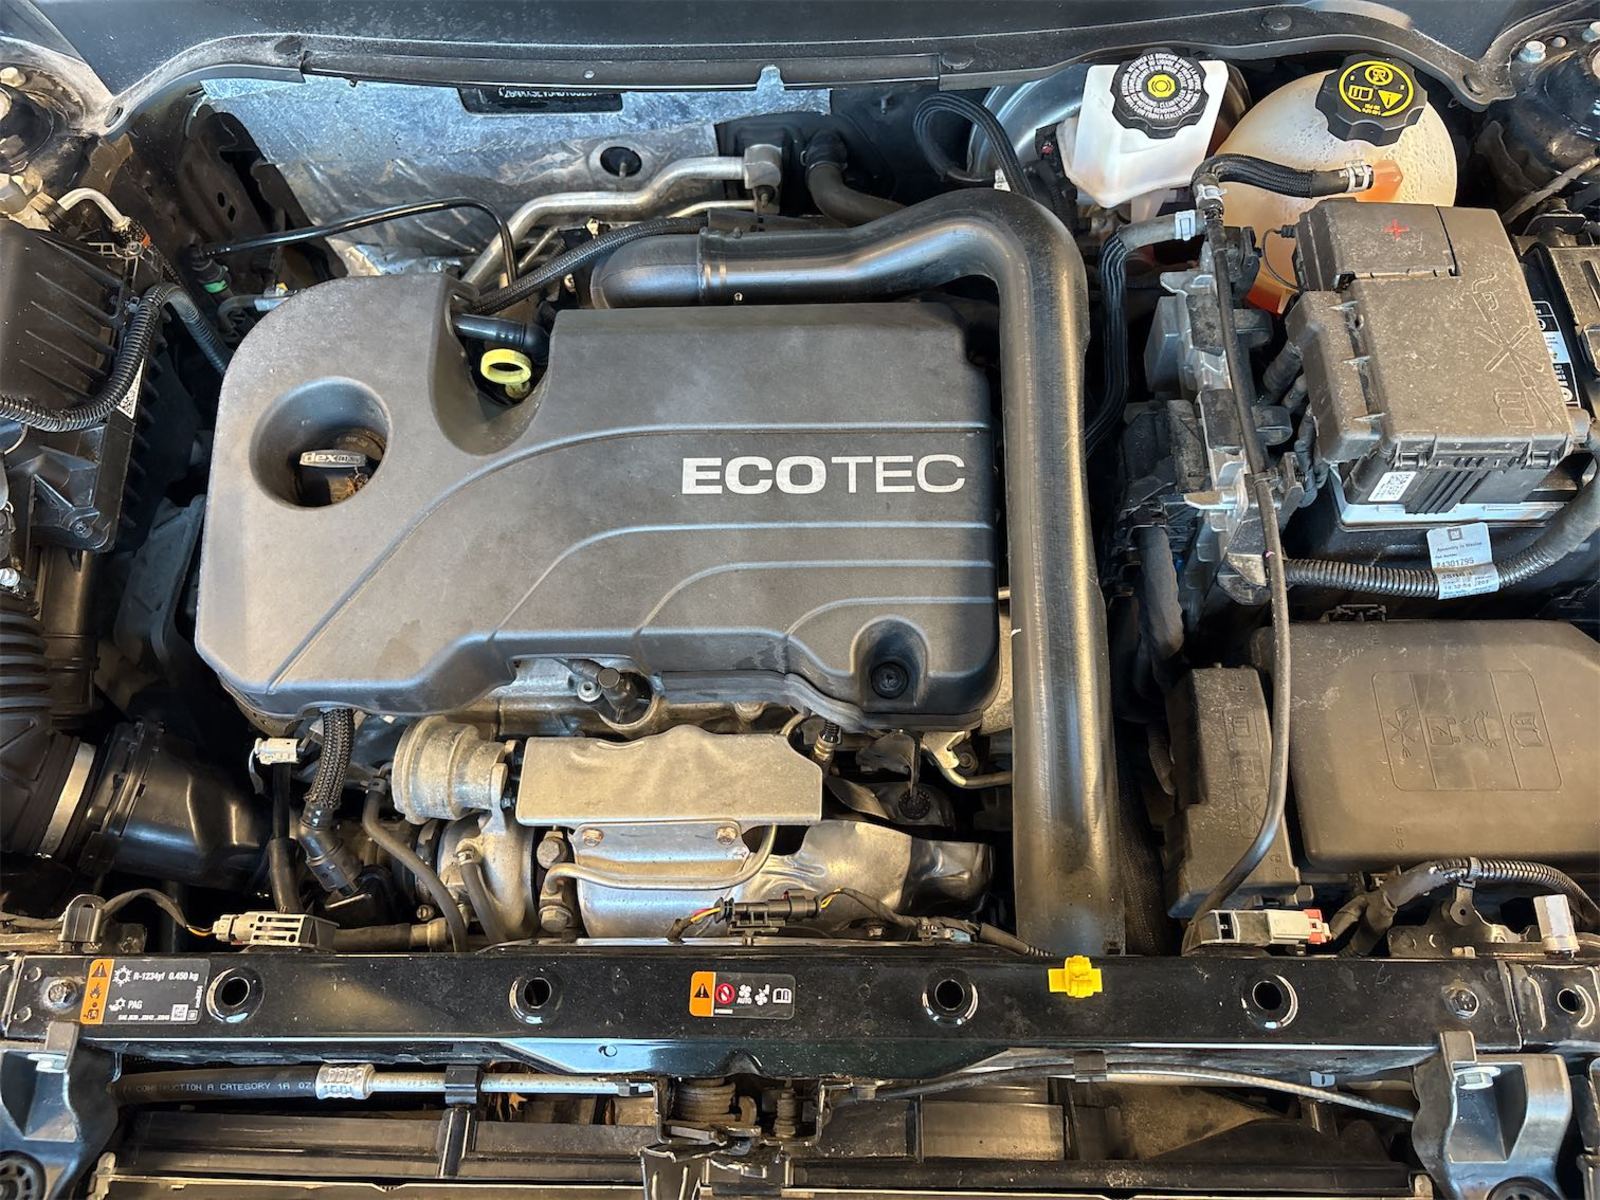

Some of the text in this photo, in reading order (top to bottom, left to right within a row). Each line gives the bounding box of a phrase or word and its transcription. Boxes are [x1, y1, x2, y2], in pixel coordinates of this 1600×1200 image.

[682, 454, 966, 494] ECOTEC
[133, 971, 199, 982] R-1234yf 0.450 kg
[127, 1000, 143, 1009] PAG
[220, 1082, 271, 1091] CATEGORY
